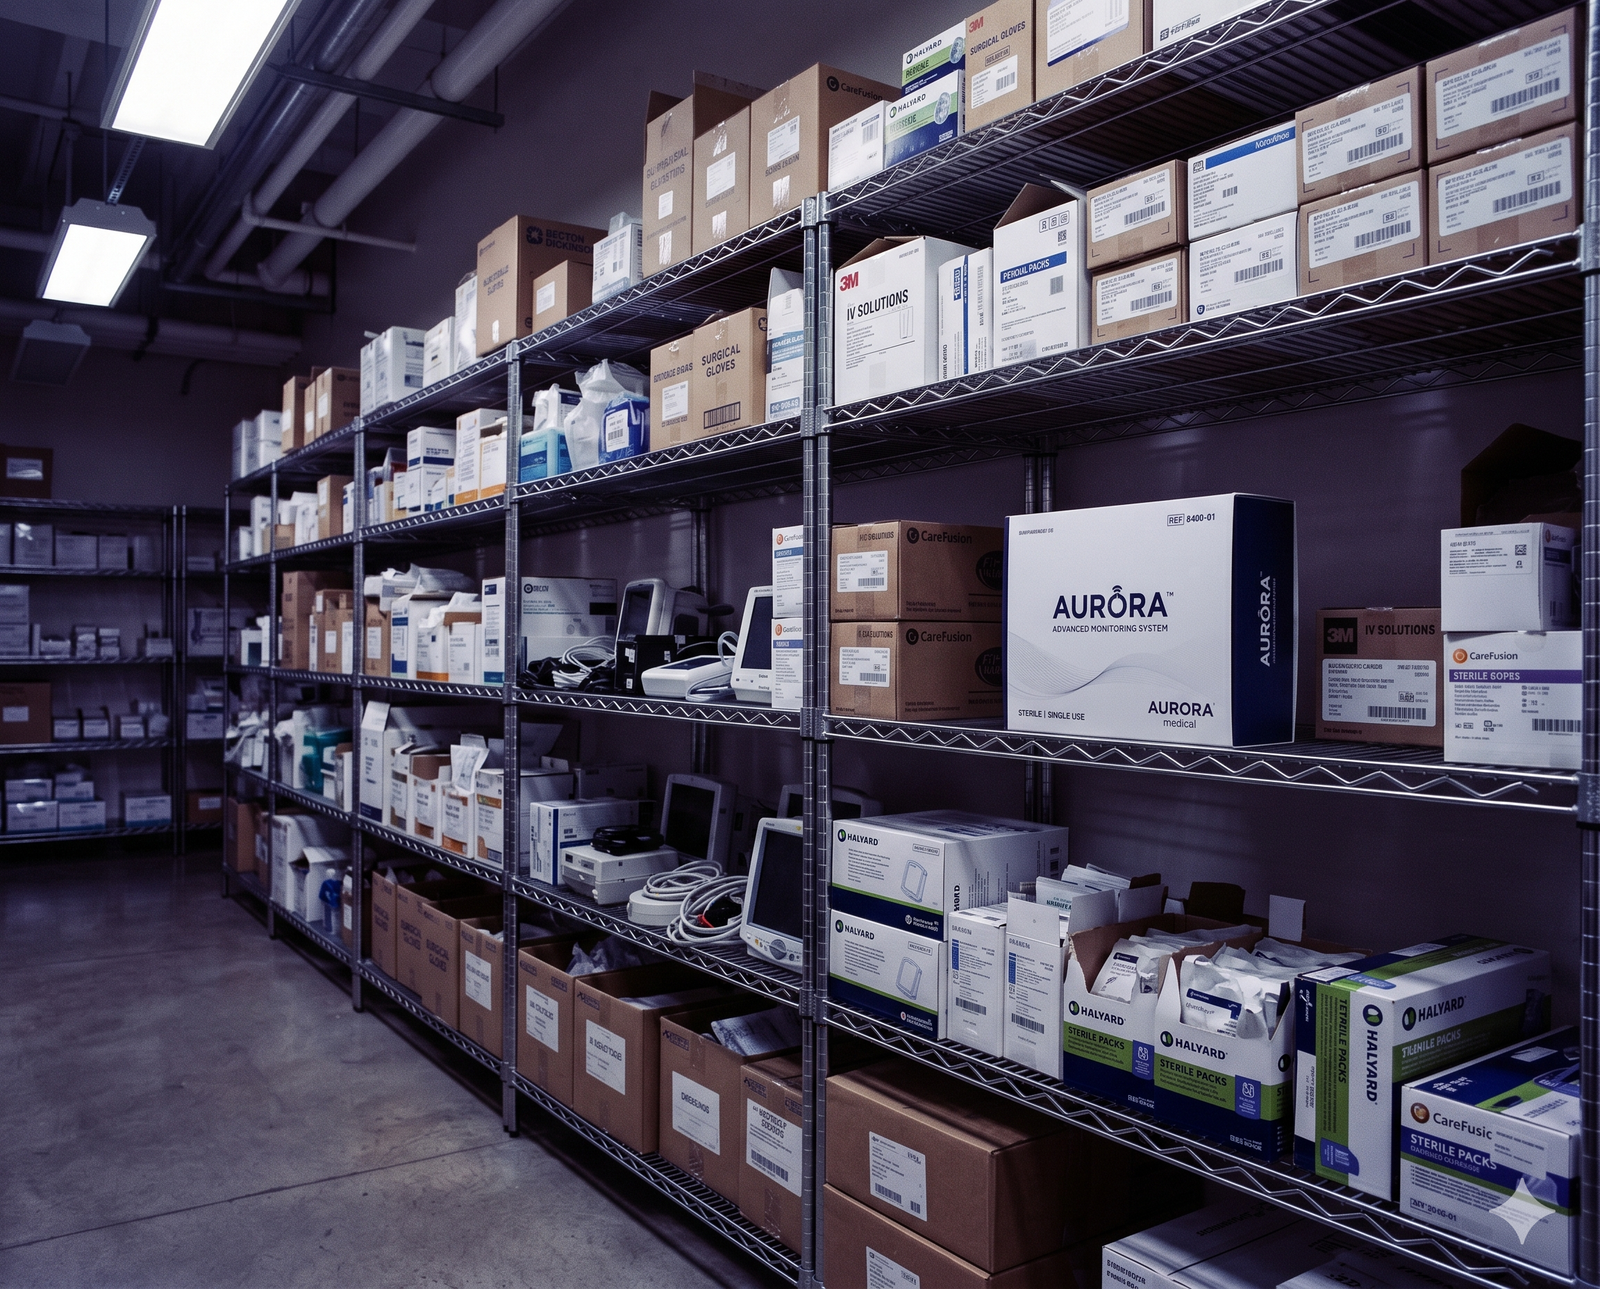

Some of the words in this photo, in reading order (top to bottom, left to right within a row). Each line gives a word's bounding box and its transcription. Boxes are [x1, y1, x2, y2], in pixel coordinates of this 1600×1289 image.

[968, 16, 984, 34] 3M
[970, 35, 1000, 56] SURGICAL
[1000, 21, 1026, 40] GLOVES
[841, 83, 884, 101] CareFusion
[545, 229, 585, 244] BECTON
[839, 271, 860, 292] 3M
[847, 306, 856, 321] IV
[857, 288, 909, 318] SOLUTIONS
[701, 343, 741, 367] SURGICAL
[706, 358, 736, 378] GLOVES
[1168, 515, 1184, 525] REF
[1186, 513, 1216, 523] 8400-01
[921, 530, 973, 545] CareFusion
[1052, 625, 1090, 633] ADVANCED
[1090, 624, 1138, 633] MONITORING
[1138, 624, 1169, 633] SYSTEM
[1259, 575, 1272, 668] AURORA
[1364, 625, 1376, 636] IV
[1378, 624, 1436, 636] SOLUTIONS
[921, 631, 973, 643] CareFusion
[1327, 628, 1354, 643] 3M
[1469, 651, 1519, 661] CareFusion
[1453, 671, 1489, 681] STERILE
[1018, 709, 1043, 719] STERILE
[1047, 711, 1071, 720] SINGLE
[1071, 712, 1085, 721] USE
[1148, 700, 1214, 717] AURORA
[1163, 718, 1197, 729] medical
[847, 832, 879, 847] HALYARD
[1080, 1006, 1125, 1026] HALYARD
[1418, 996, 1465, 1022] HALYARD
[1068, 1026, 1097, 1042] STERILE
[1098, 1035, 1125, 1050] PACKS
[1175, 1038, 1226, 1060] HALYARD
[1159, 1058, 1194, 1077] STERILE
[1196, 1070, 1228, 1087] PACKS
[1337, 1048, 1348, 1084] PACKS
[1366, 1029, 1378, 1102] HALYARD
[1410, 1133, 1456, 1157] STERILE
[1458, 1148, 1498, 1170] PACKS
